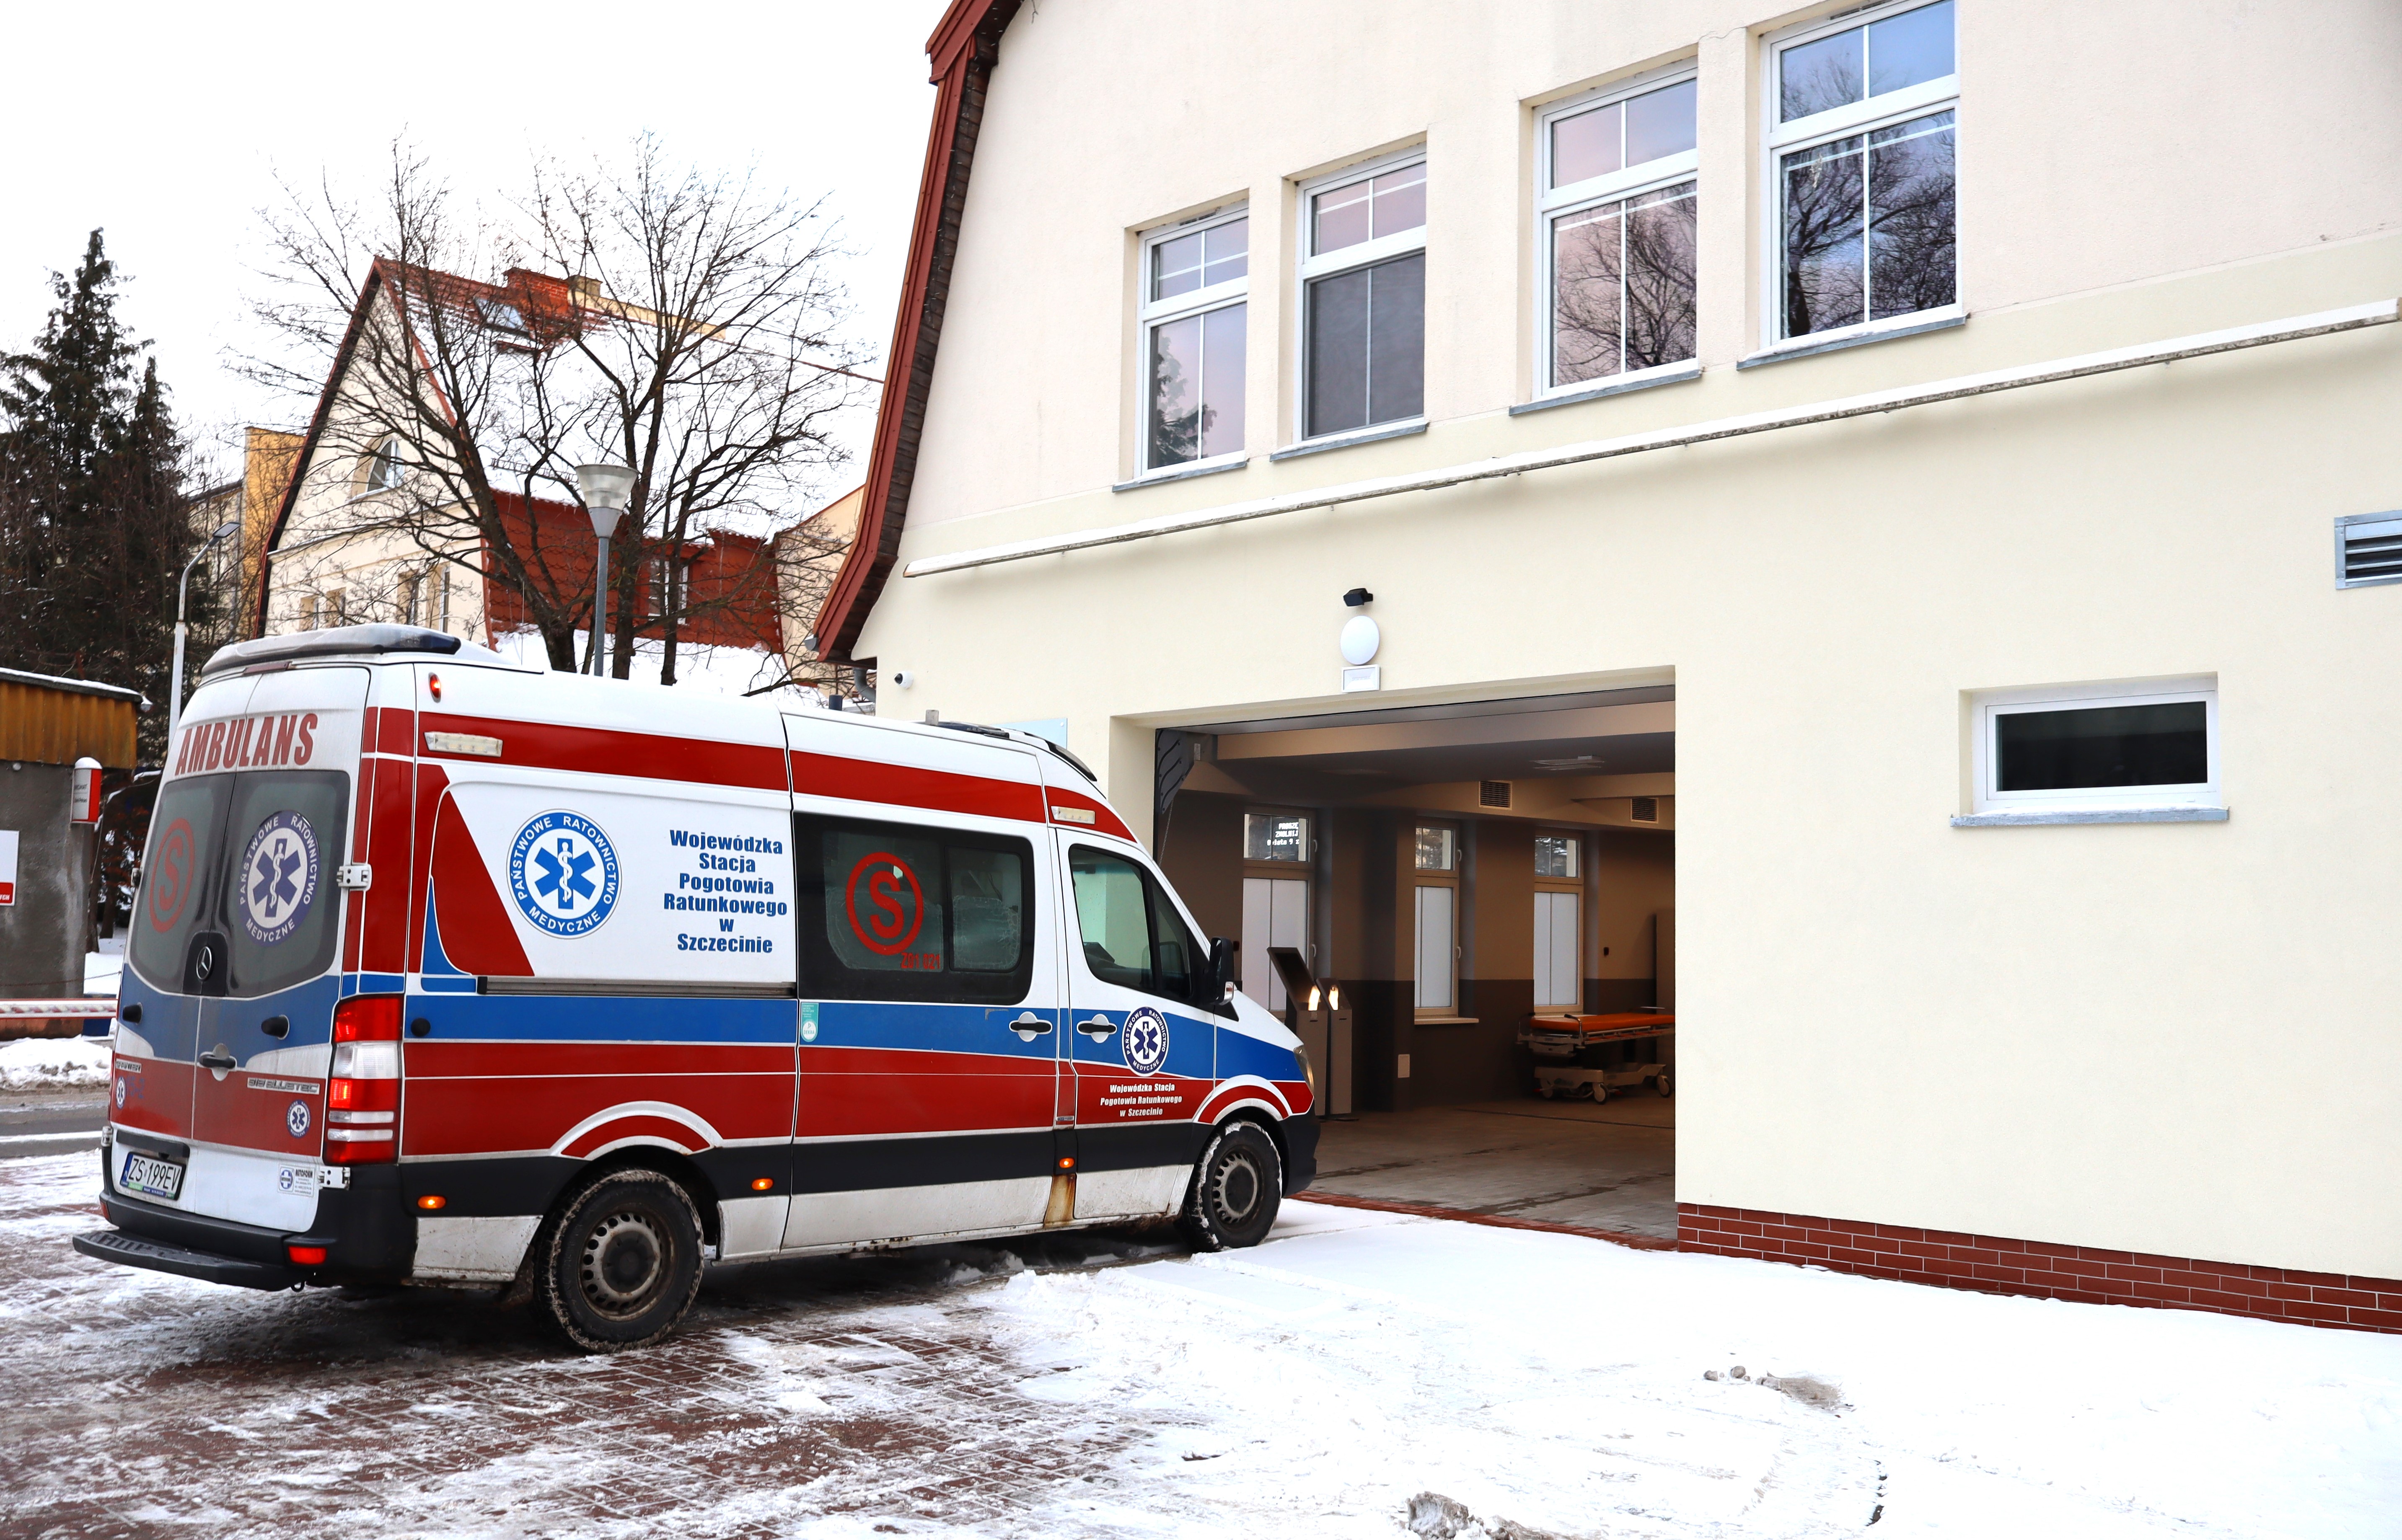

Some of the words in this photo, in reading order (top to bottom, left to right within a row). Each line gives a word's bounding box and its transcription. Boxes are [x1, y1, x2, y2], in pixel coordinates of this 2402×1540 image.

[175, 713, 318, 776] AMBULANS
[670, 829, 783, 854] Wojewódzka
[240, 816, 279, 904] PAŃSTWOWE
[291, 815, 317, 904] RATOWNICTWO
[511, 817, 552, 900] PAŃSTWOWE
[563, 816, 617, 904] RATOWNICTWO
[699, 853, 756, 873] Stacja
[159, 835, 183, 911] S
[679, 873, 774, 894] Pogotowia
[664, 893, 787, 917] Ratunkowego
[869, 871, 904, 939] S
[246, 918, 295, 942] MEDYCZNE
[529, 906, 601, 932] MEDYCZNE
[719, 918, 734, 932] w
[677, 933, 773, 953] Szczecinie
[923, 952, 940, 969] 021
[1125, 1010, 1142, 1055] PAŃSTWOWE
[1149, 1010, 1167, 1052] RATOWNICTWO
[1132, 1059, 1160, 1071] MEDYCZNE
[1110, 1083, 1152, 1093] Wojewódzka
[1154, 1083, 1175, 1092] Stacja
[1100, 1096, 1136, 1106] Pogotowia
[1138, 1096, 1182, 1104] Ratunkowego
[1128, 1107, 1163, 1116] Szczecinie
[128, 1158, 145, 1182] ZS
[147, 1163, 181, 1191] 199EV
